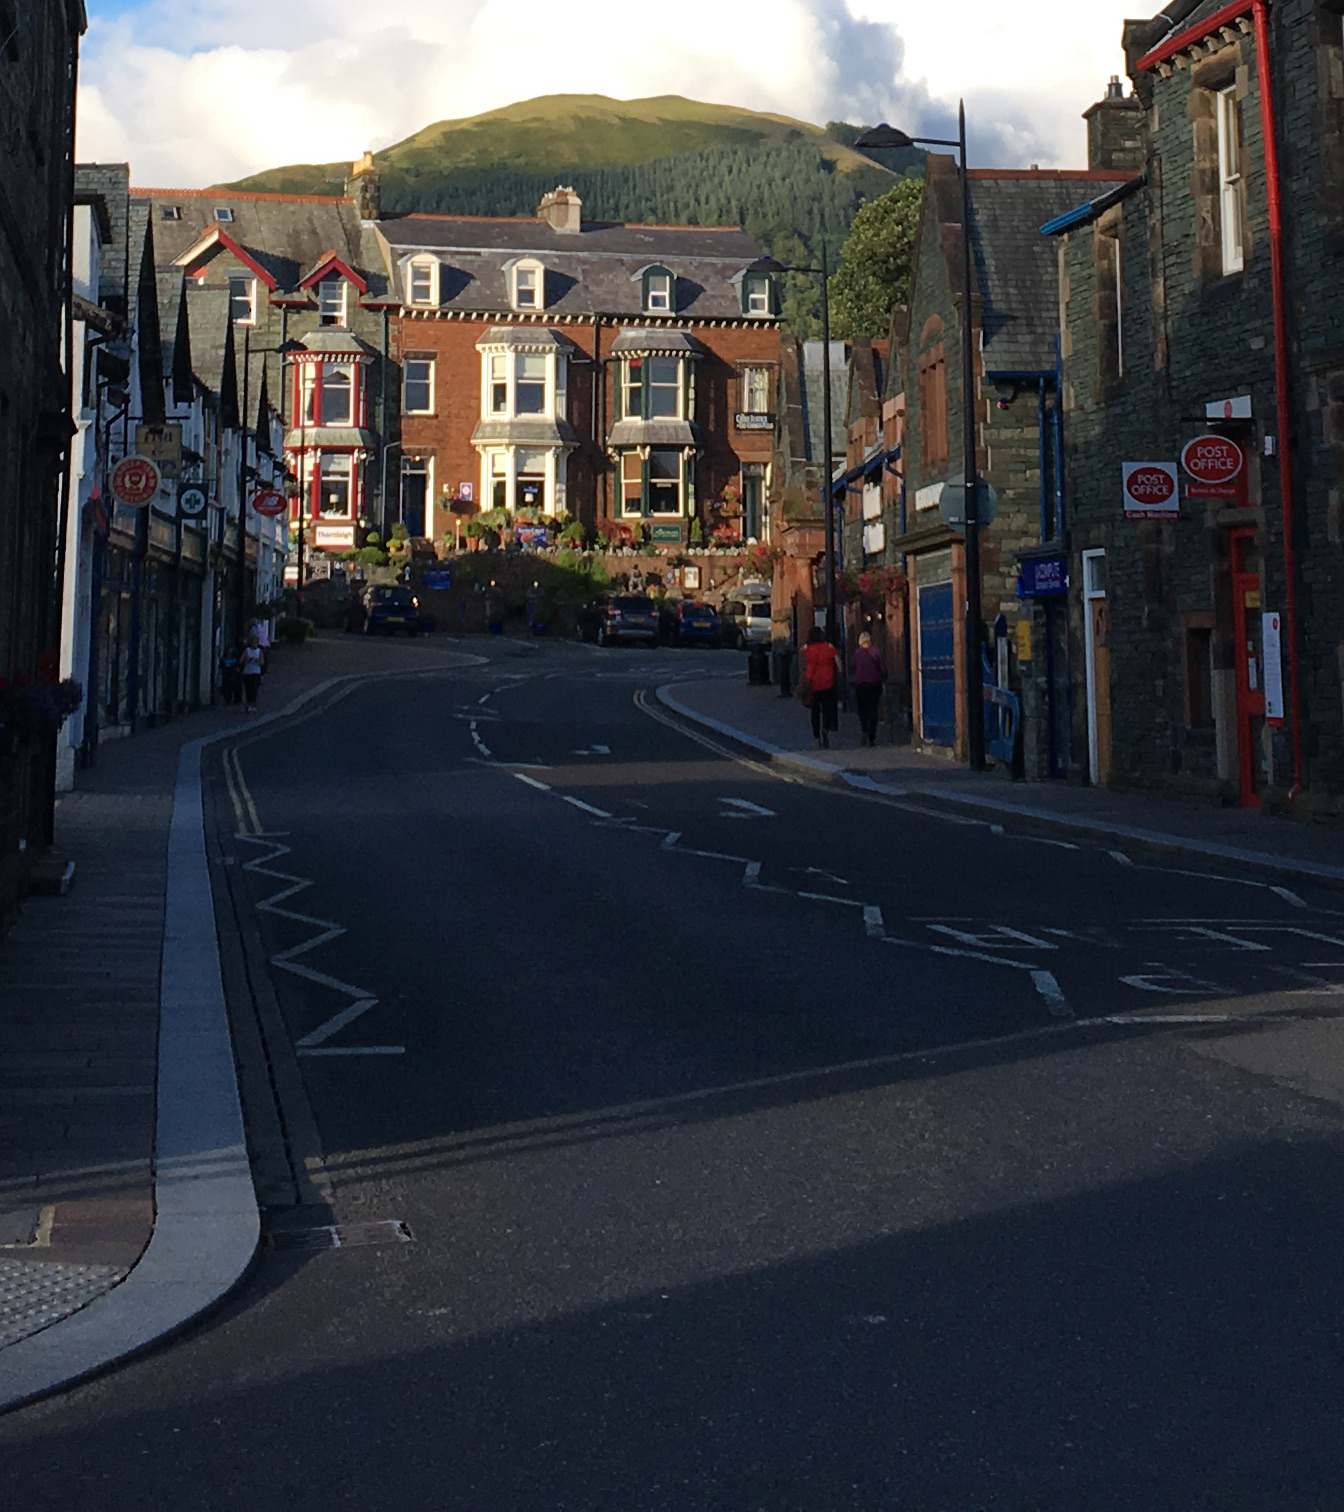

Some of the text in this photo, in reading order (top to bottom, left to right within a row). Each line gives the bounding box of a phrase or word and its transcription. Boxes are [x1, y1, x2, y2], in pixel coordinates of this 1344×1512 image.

[1196, 445, 1229, 458] POST
[1189, 458, 1235, 471] OFFICE
[1137, 473, 1165, 484] POST
[1131, 484, 1170, 496] OFFICE
[1126, 510, 1178, 519] Cash Machine
